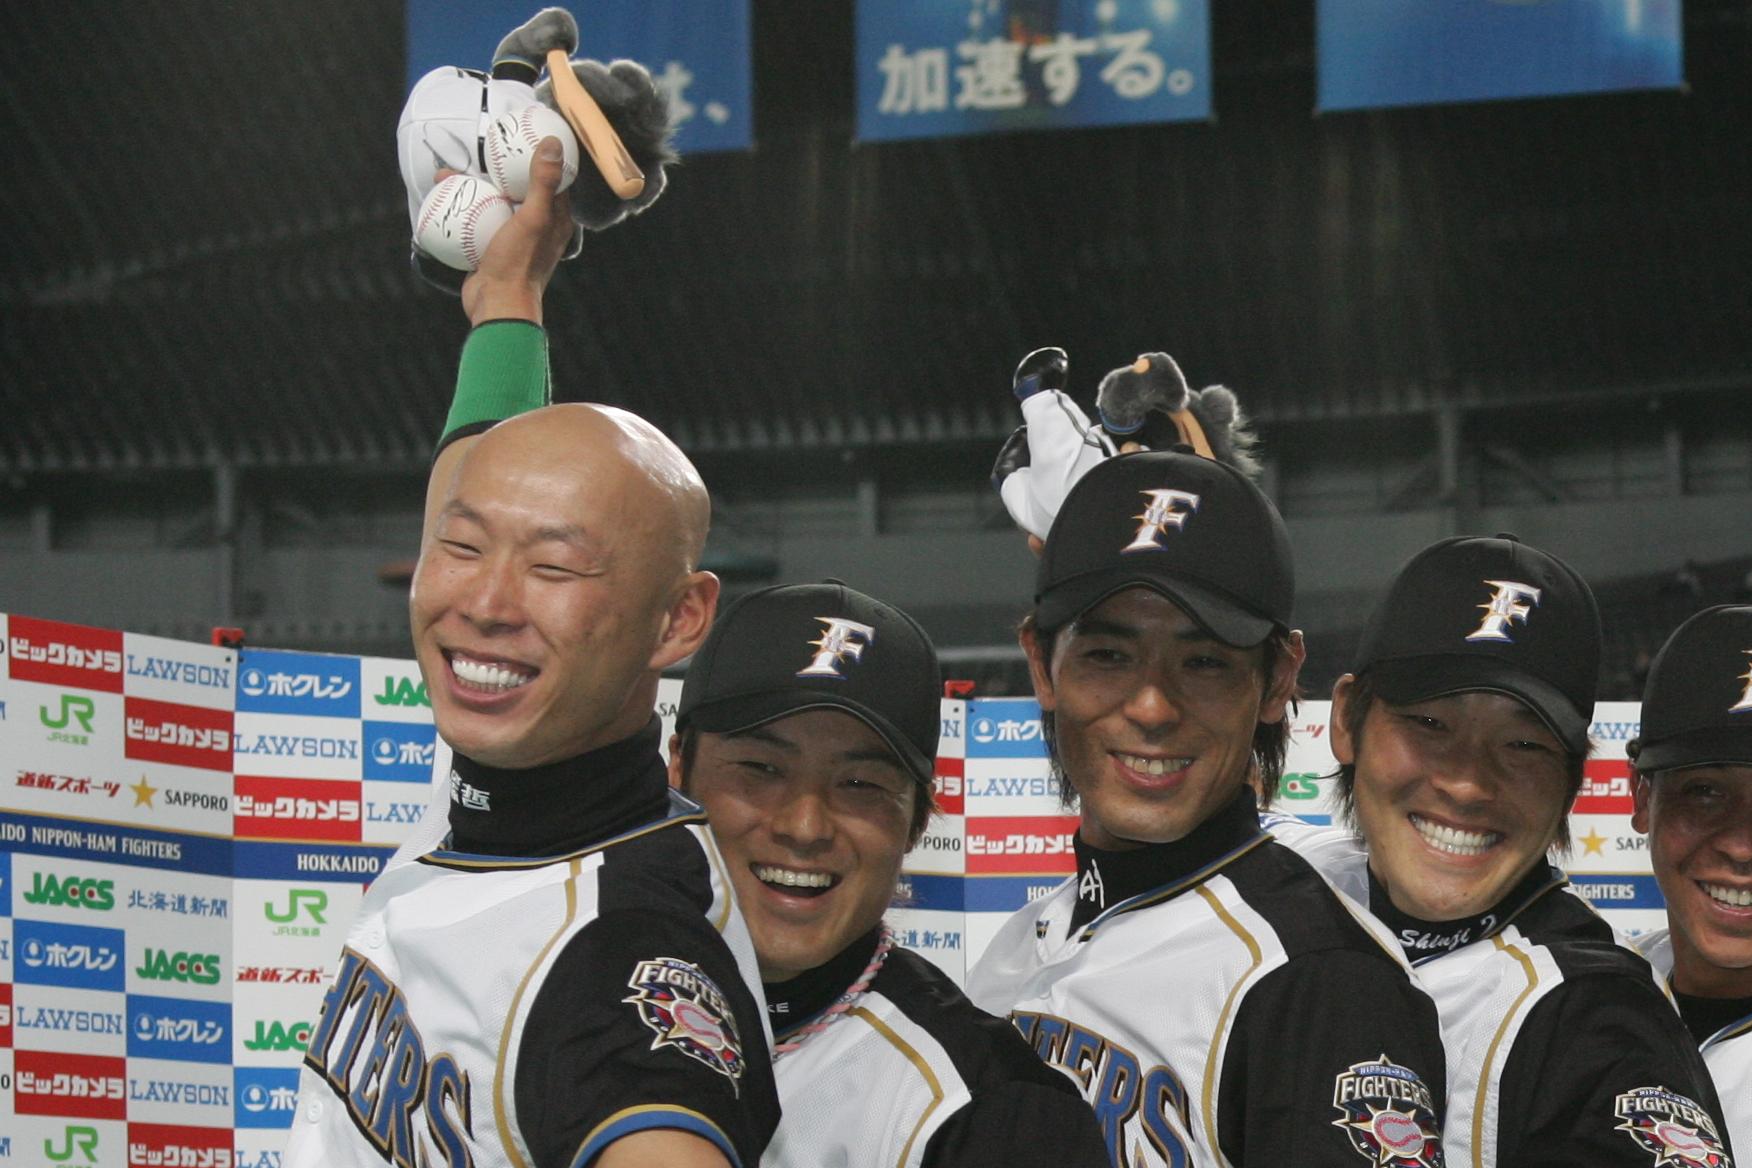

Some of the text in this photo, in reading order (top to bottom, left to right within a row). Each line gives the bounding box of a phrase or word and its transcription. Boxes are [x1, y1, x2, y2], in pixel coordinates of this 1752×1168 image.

[878, 29, 1195, 114] 加速する。
[1120, 488, 1200, 555] F
[1465, 580, 1541, 643] F
[11, 637, 121, 673] ビックカメラ
[795, 616, 876, 680] F
[127, 654, 229, 689] LAWSON
[267, 671, 352, 699] ホクレン
[40, 694, 94, 733] JR
[127, 717, 229, 751] ビックカメラ
[234, 733, 359, 760] LAWSON
[16, 769, 120, 798] 道新スポーツ
[165, 789, 228, 811] SAPPORO
[233, 796, 361, 823] ビックカメラ
[32, 827, 116, 852] NIPPON-HAM
[122, 838, 181, 860] FIGHTERS
[297, 853, 379, 874] HOKKAIDO
[23, 872, 115, 911] JACCS
[128, 890, 228, 918] 北海道新聞
[264, 888, 328, 925] JR
[1400, 927, 1471, 951] Shinji
[46, 942, 117, 971] ホクレン
[136, 948, 221, 985] JACCS
[17, 1006, 123, 1035] LAWSON
[156, 1017, 223, 1044] ホクレン
[16, 1071, 125, 1100] ビックカメラ
[130, 1080, 229, 1106] LAWSON
[44, 1125, 98, 1163] JR
[129, 1143, 231, 1168] ビックカメラ
